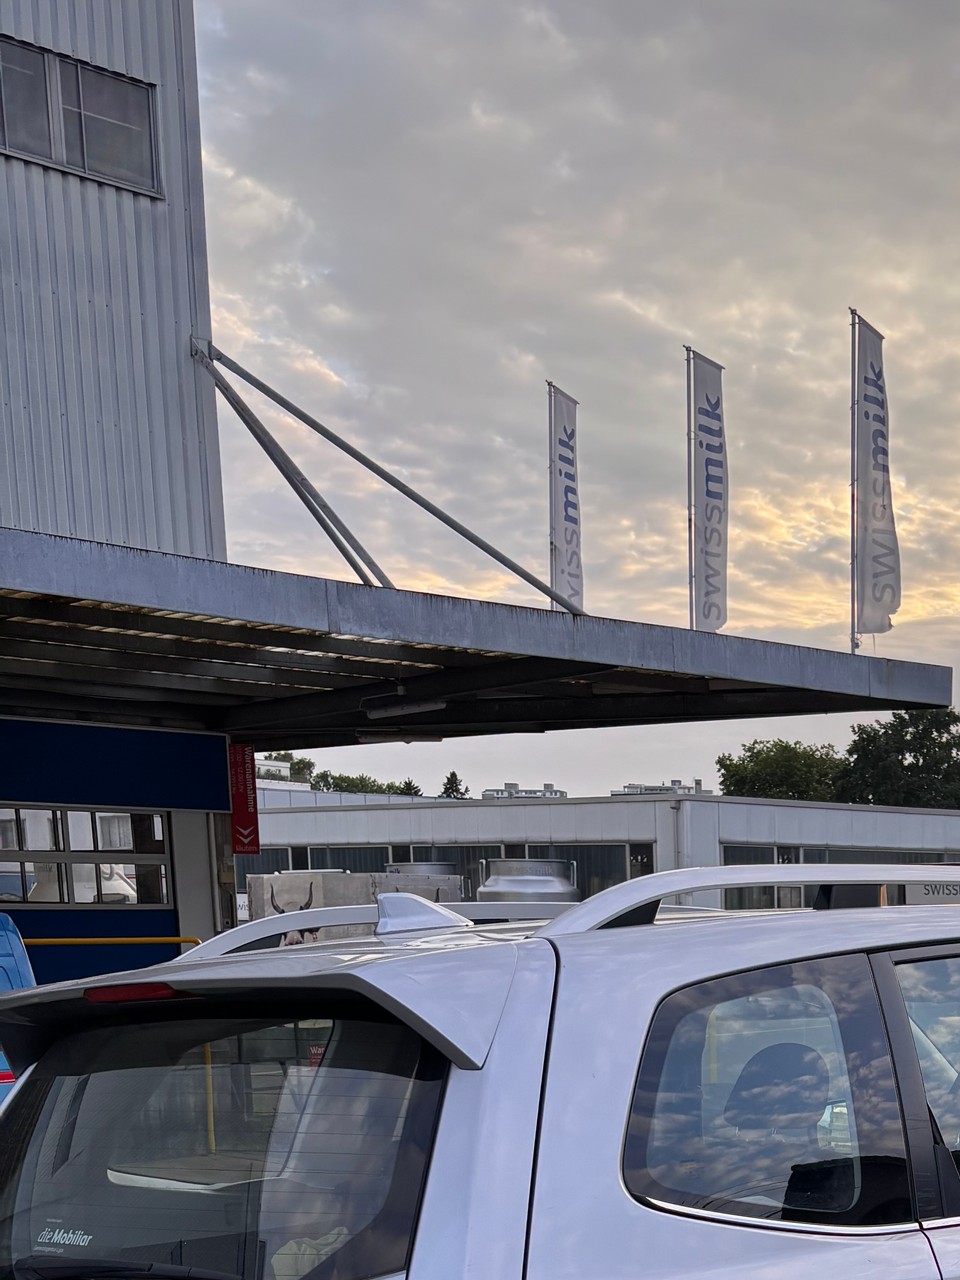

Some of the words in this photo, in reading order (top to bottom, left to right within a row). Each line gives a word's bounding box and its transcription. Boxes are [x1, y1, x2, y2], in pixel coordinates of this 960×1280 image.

[558, 425, 581, 606] wissmilk
[698, 392, 725, 621] swissmilk
[863, 361, 897, 606] swissmilk
[244, 746, 256, 813] Warenannahme
